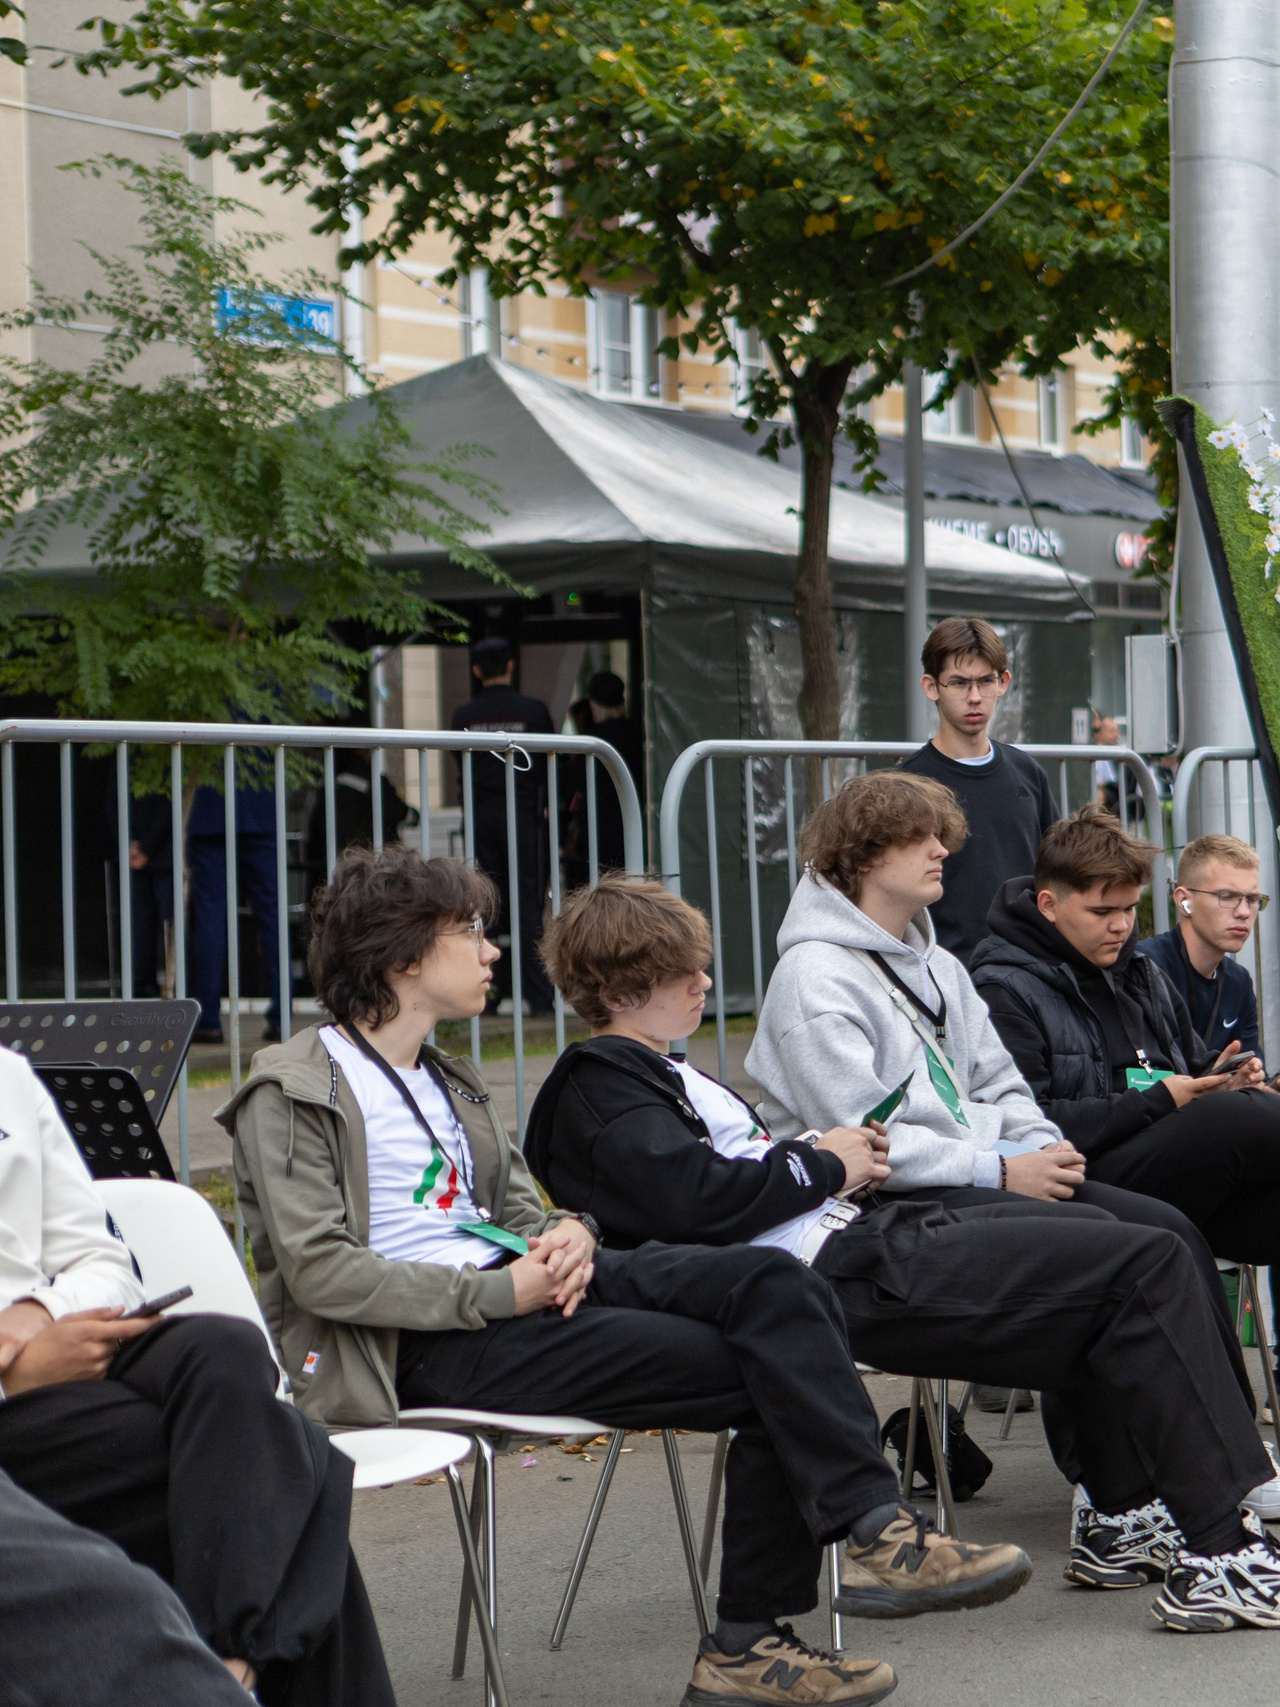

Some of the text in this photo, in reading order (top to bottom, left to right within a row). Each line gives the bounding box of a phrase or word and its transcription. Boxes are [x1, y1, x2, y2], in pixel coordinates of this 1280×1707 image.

[308, 309, 330, 337] 39
[1007, 523, 1062, 558] ОБУВЬ
[110, 1012, 166, 1029] Gravity
[891, 1541, 931, 1574] N
[761, 1659, 806, 1691] N
